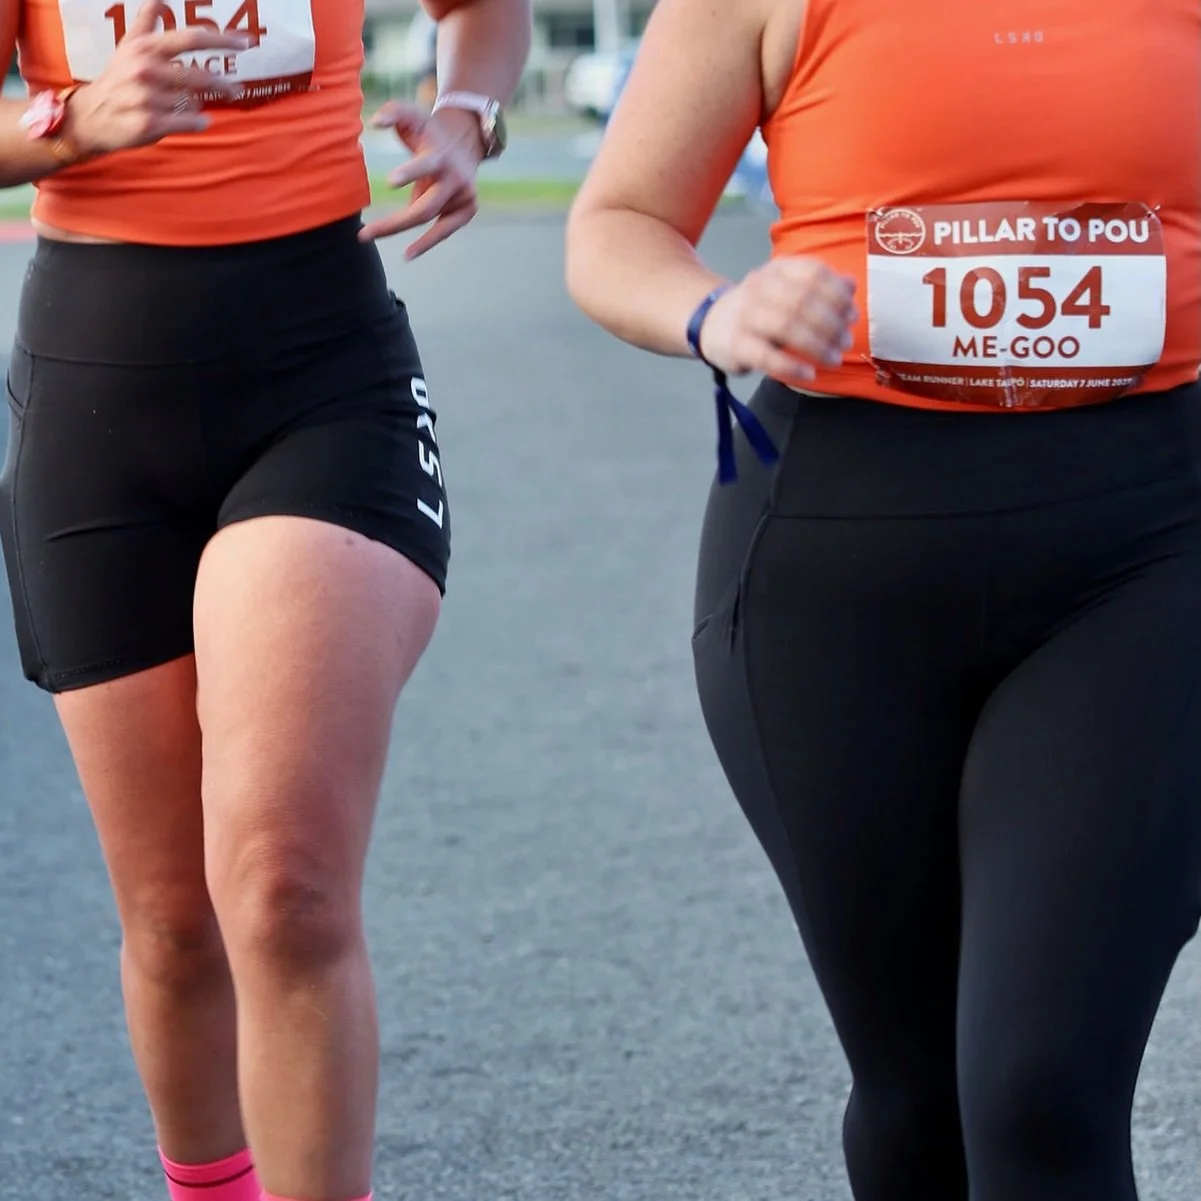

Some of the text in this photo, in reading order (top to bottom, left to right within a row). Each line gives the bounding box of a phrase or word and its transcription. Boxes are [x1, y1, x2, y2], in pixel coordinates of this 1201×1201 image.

[170, 54, 238, 77] ACE
[933, 218, 1036, 246] PILLAR
[1042, 216, 1081, 242] TO
[1087, 218, 1150, 243] POU
[922, 265, 1111, 330] 1054
[951, 335, 1081, 359] ME-GOO
[969, 377, 995, 388] LAKE
[1030, 378, 1079, 389] SATURDAY
[1086, 378, 1111, 388] JUNE
